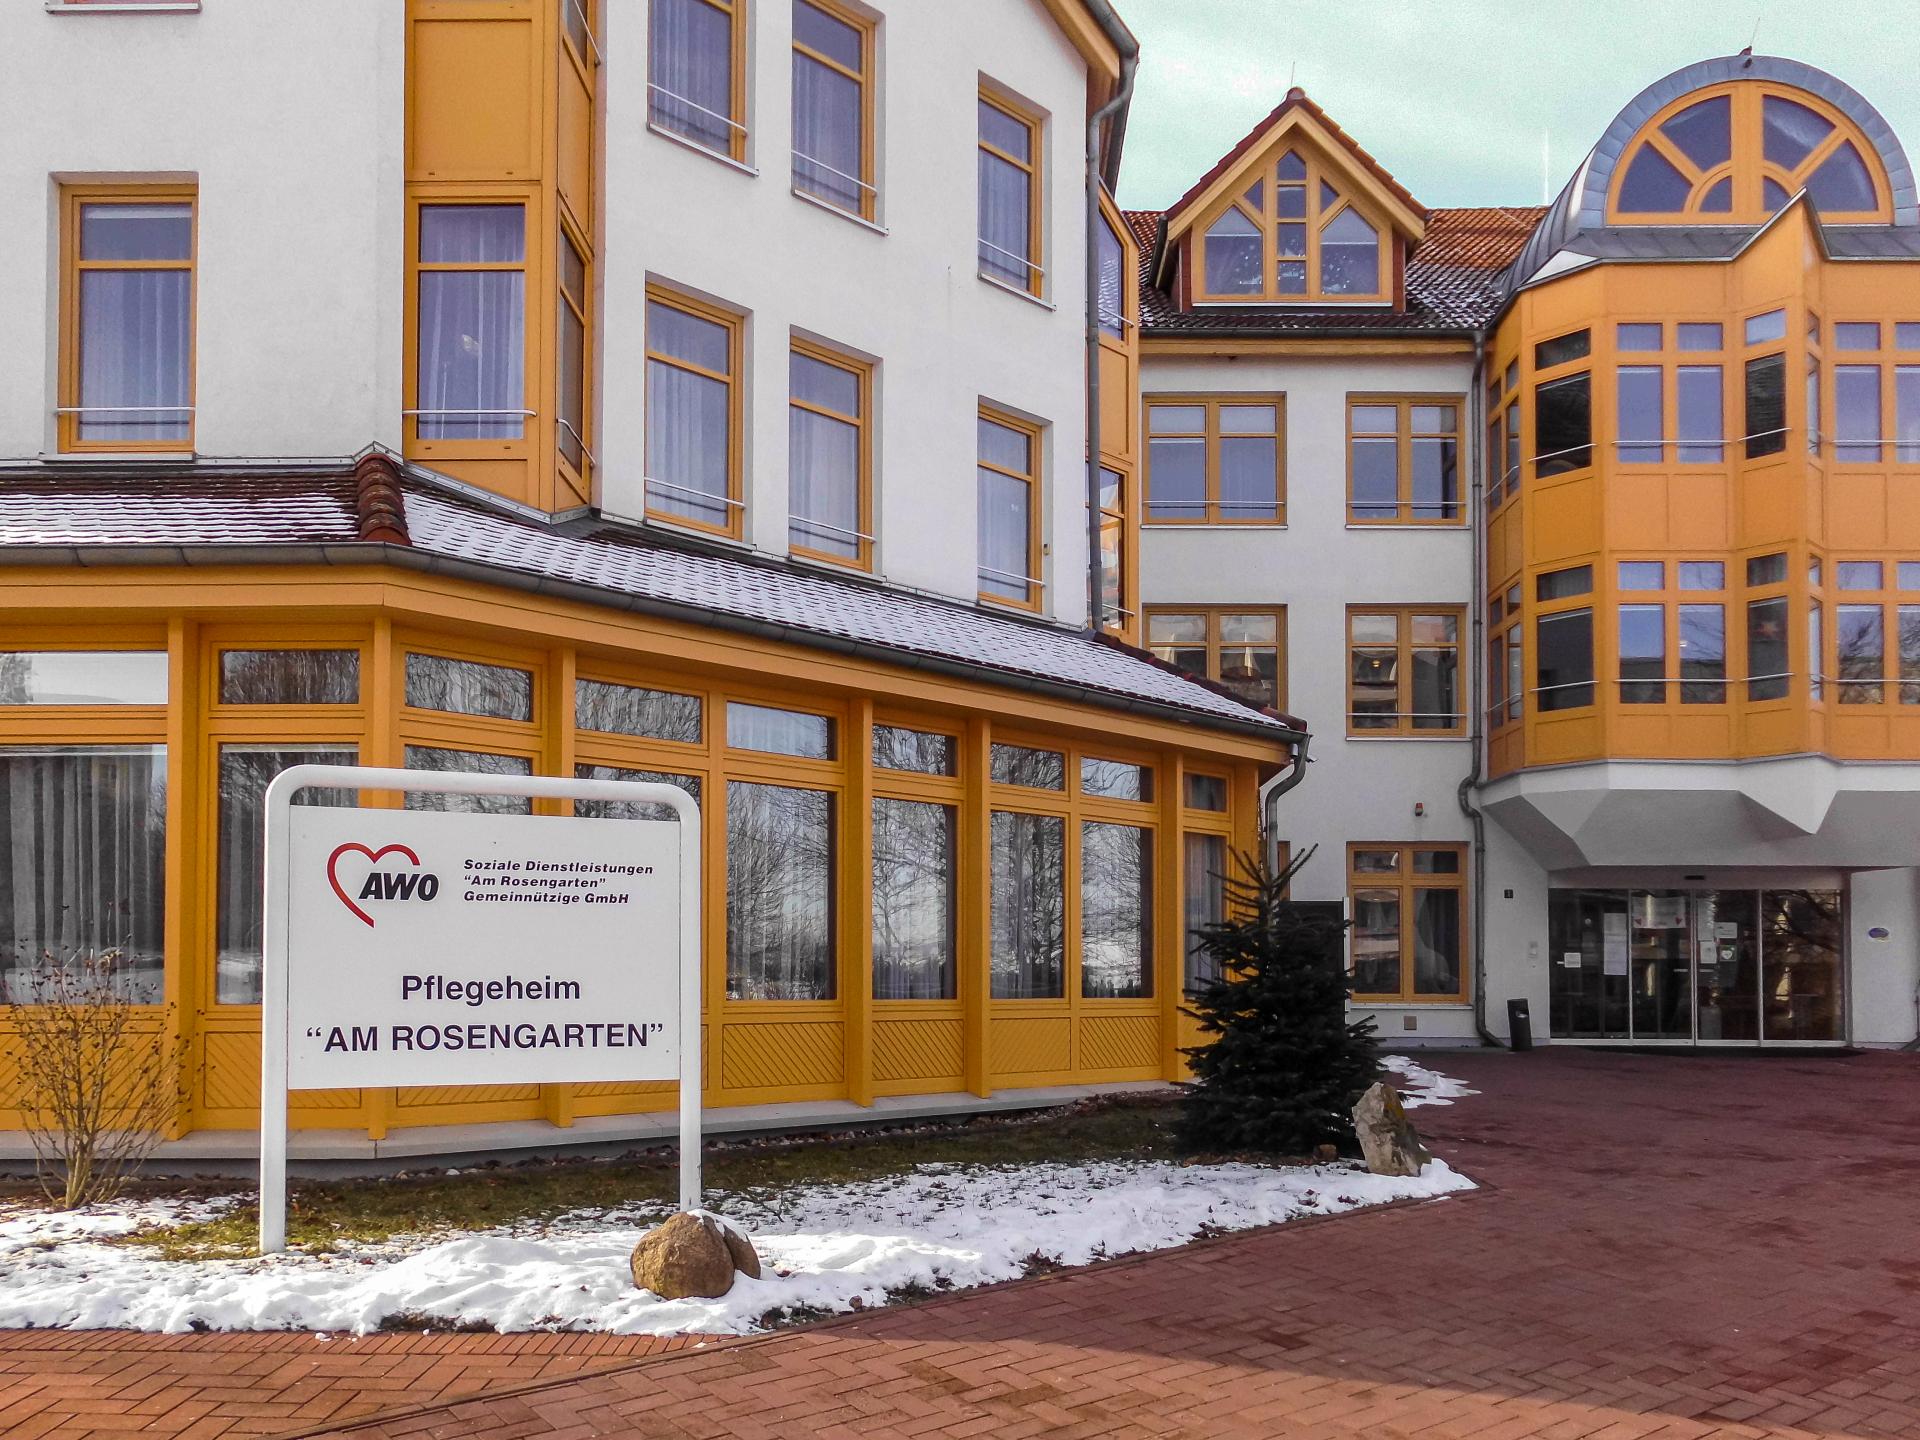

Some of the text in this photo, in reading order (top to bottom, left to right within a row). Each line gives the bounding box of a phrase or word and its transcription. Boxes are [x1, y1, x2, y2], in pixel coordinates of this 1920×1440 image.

[463, 859, 654, 876] Soziale Dienstleistungen
[359, 872, 439, 901] AWO
[463, 890, 629, 905] Gemeinnützige GmbH
[402, 974, 580, 1006] Pflegeheim
